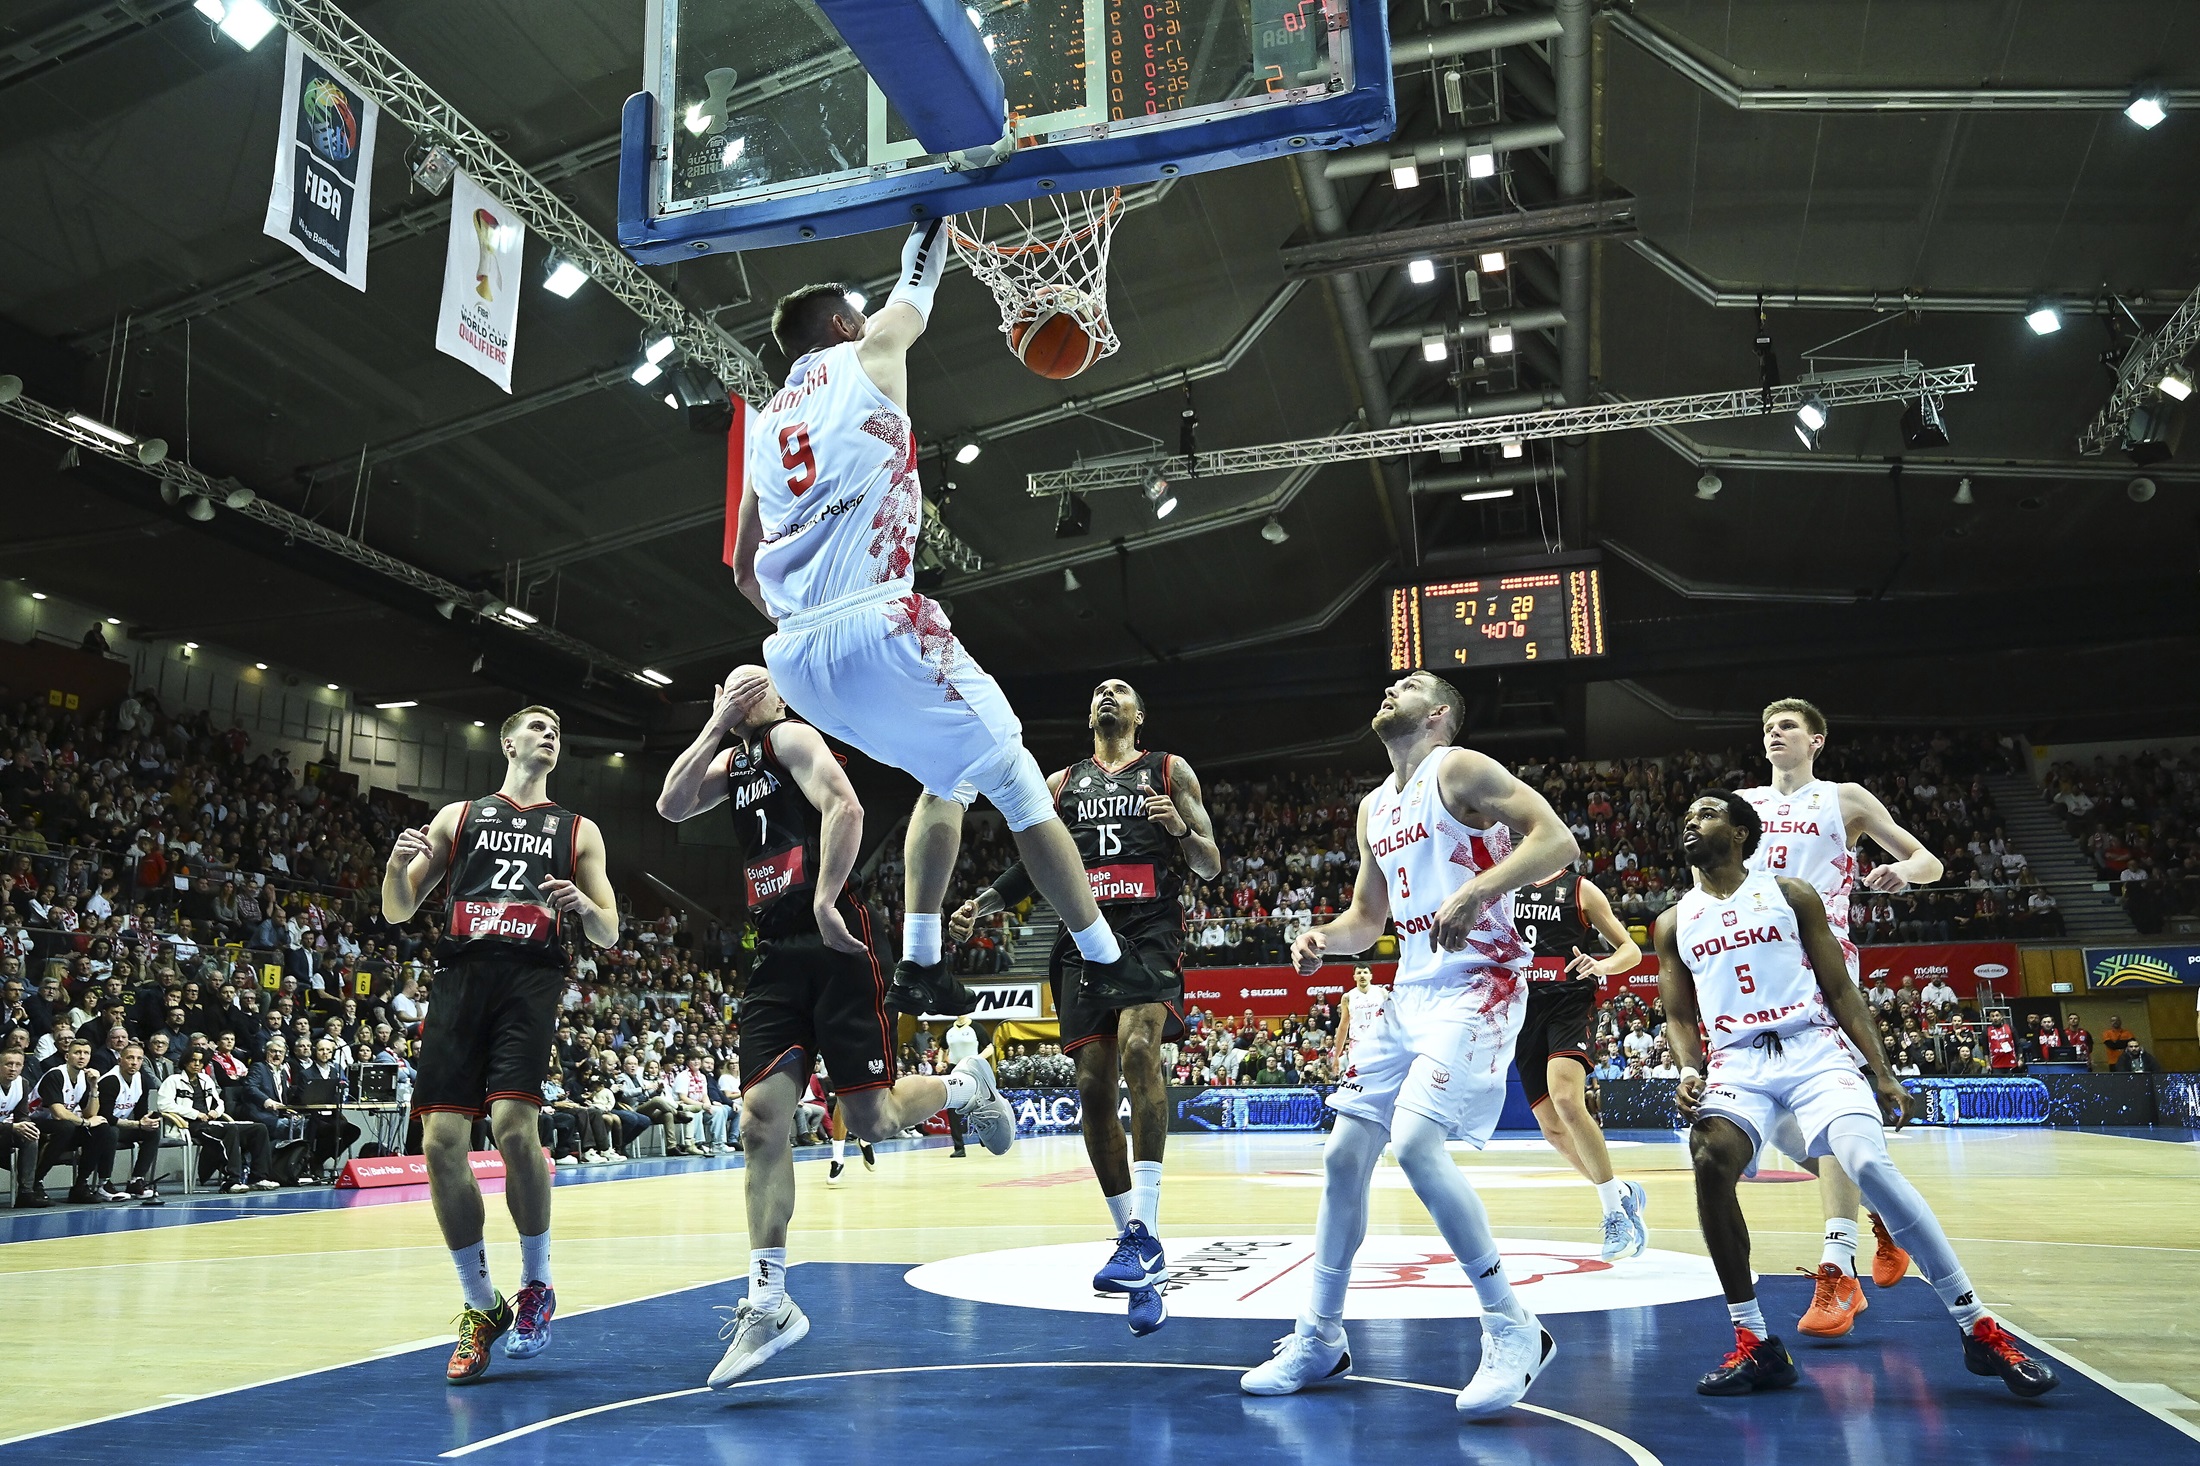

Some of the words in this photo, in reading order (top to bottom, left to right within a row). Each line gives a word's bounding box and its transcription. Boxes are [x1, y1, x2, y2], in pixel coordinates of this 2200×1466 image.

[304, 164, 342, 221] FIBA
[477, 306, 489, 320] FIBA
[460, 309, 487, 338] WORLD
[488, 333, 508, 348] CUP
[458, 322, 507, 365] QUALIFIERS
[779, 421, 817, 498] 9
[1455, 601, 1477, 619] 37
[1488, 603, 1497, 616] 2
[1511, 595, 1534, 613] 28
[1455, 648, 1467, 664] 4
[1526, 642, 1537, 660] 5
[730, 770, 750, 778] CRAFT
[1077, 794, 1146, 823] AUSTRIA
[755, 808, 768, 846] 1
[474, 829, 554, 859] AUSTRIA
[1097, 823, 1122, 857] 15
[1371, 822, 1430, 859] POLSKA
[1767, 845, 1788, 870] 13
[490, 858, 529, 891] 22
[756, 864, 775, 879] lebe
[1397, 866, 1411, 899] 3
[1091, 879, 1144, 898] airplay
[465, 902, 481, 914] Es
[481, 906, 506, 917] lebe
[1515, 903, 1562, 922] USTRIA
[470, 917, 537, 938] Fairplay
[1524, 924, 1538, 949] 9
[1691, 925, 1784, 962] POLSKA
[269, 973, 275, 986] 5
[1734, 963, 1757, 995] 5
[1868, 968, 1890, 980] 4F
[1913, 965, 1949, 975] molten
[360, 981, 366, 992] 6
[1197, 990, 1221, 1000] Pekao
[1251, 988, 1288, 998] SUZUKI
[1340, 1080, 1364, 1093] ZUKI
[1954, 1290, 1974, 1307] 4F
